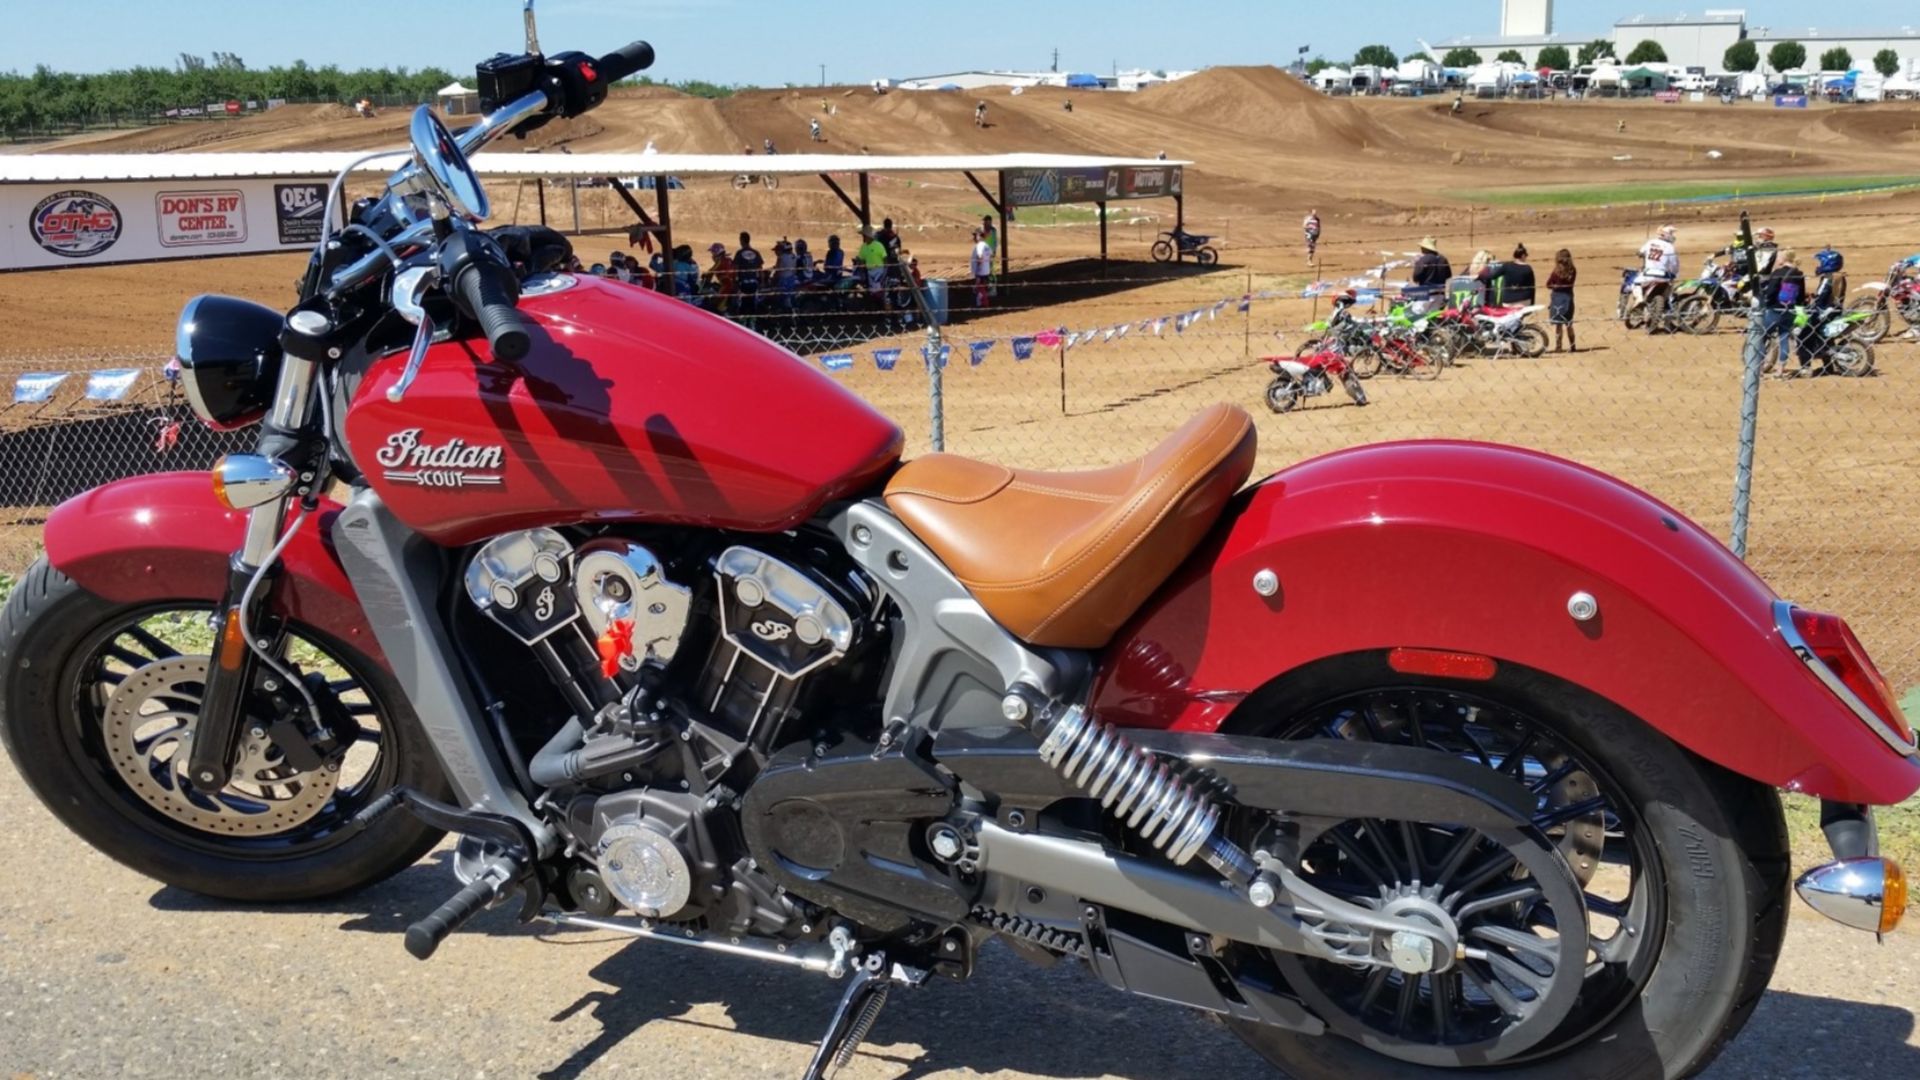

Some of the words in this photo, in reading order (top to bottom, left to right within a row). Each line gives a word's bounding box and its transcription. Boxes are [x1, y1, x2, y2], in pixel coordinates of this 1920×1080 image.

[163, 198, 214, 215] DON'S
[217, 197, 239, 212] RV
[280, 187, 319, 212] QEC
[179, 215, 227, 231] CENTER
[376, 428, 503, 468] Indian
[416, 469, 464, 487] SCOUT
